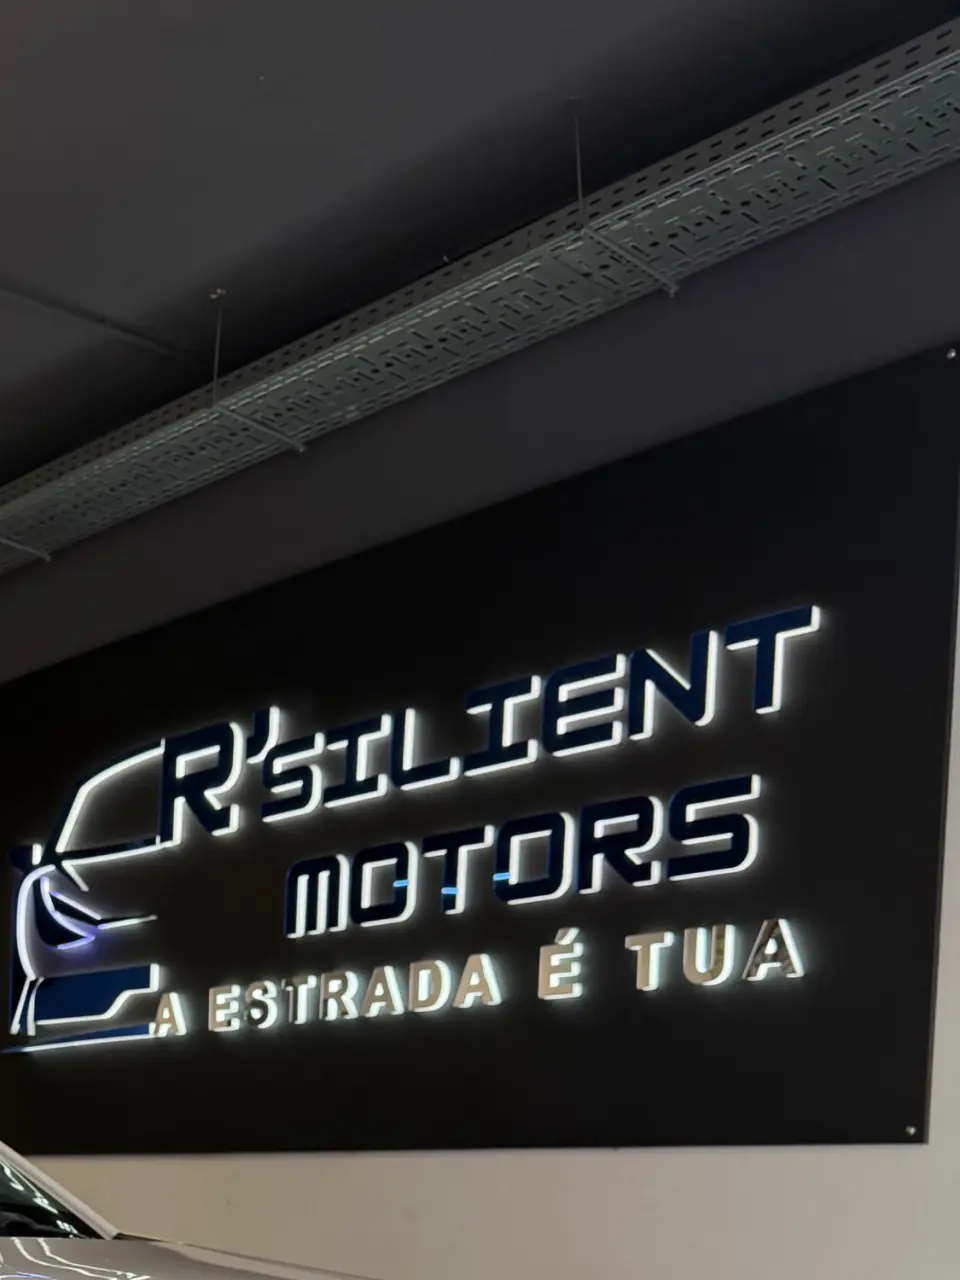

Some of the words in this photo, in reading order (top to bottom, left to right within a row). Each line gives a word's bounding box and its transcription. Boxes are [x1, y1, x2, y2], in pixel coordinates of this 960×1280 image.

[157, 605, 820, 846] R'SILIENT
[283, 774, 761, 939] MOTORS
[153, 992, 187, 1037] A
[208, 953, 502, 1032] ESTRADA
[538, 927, 584, 1000] É
[624, 918, 805, 991] TUA
